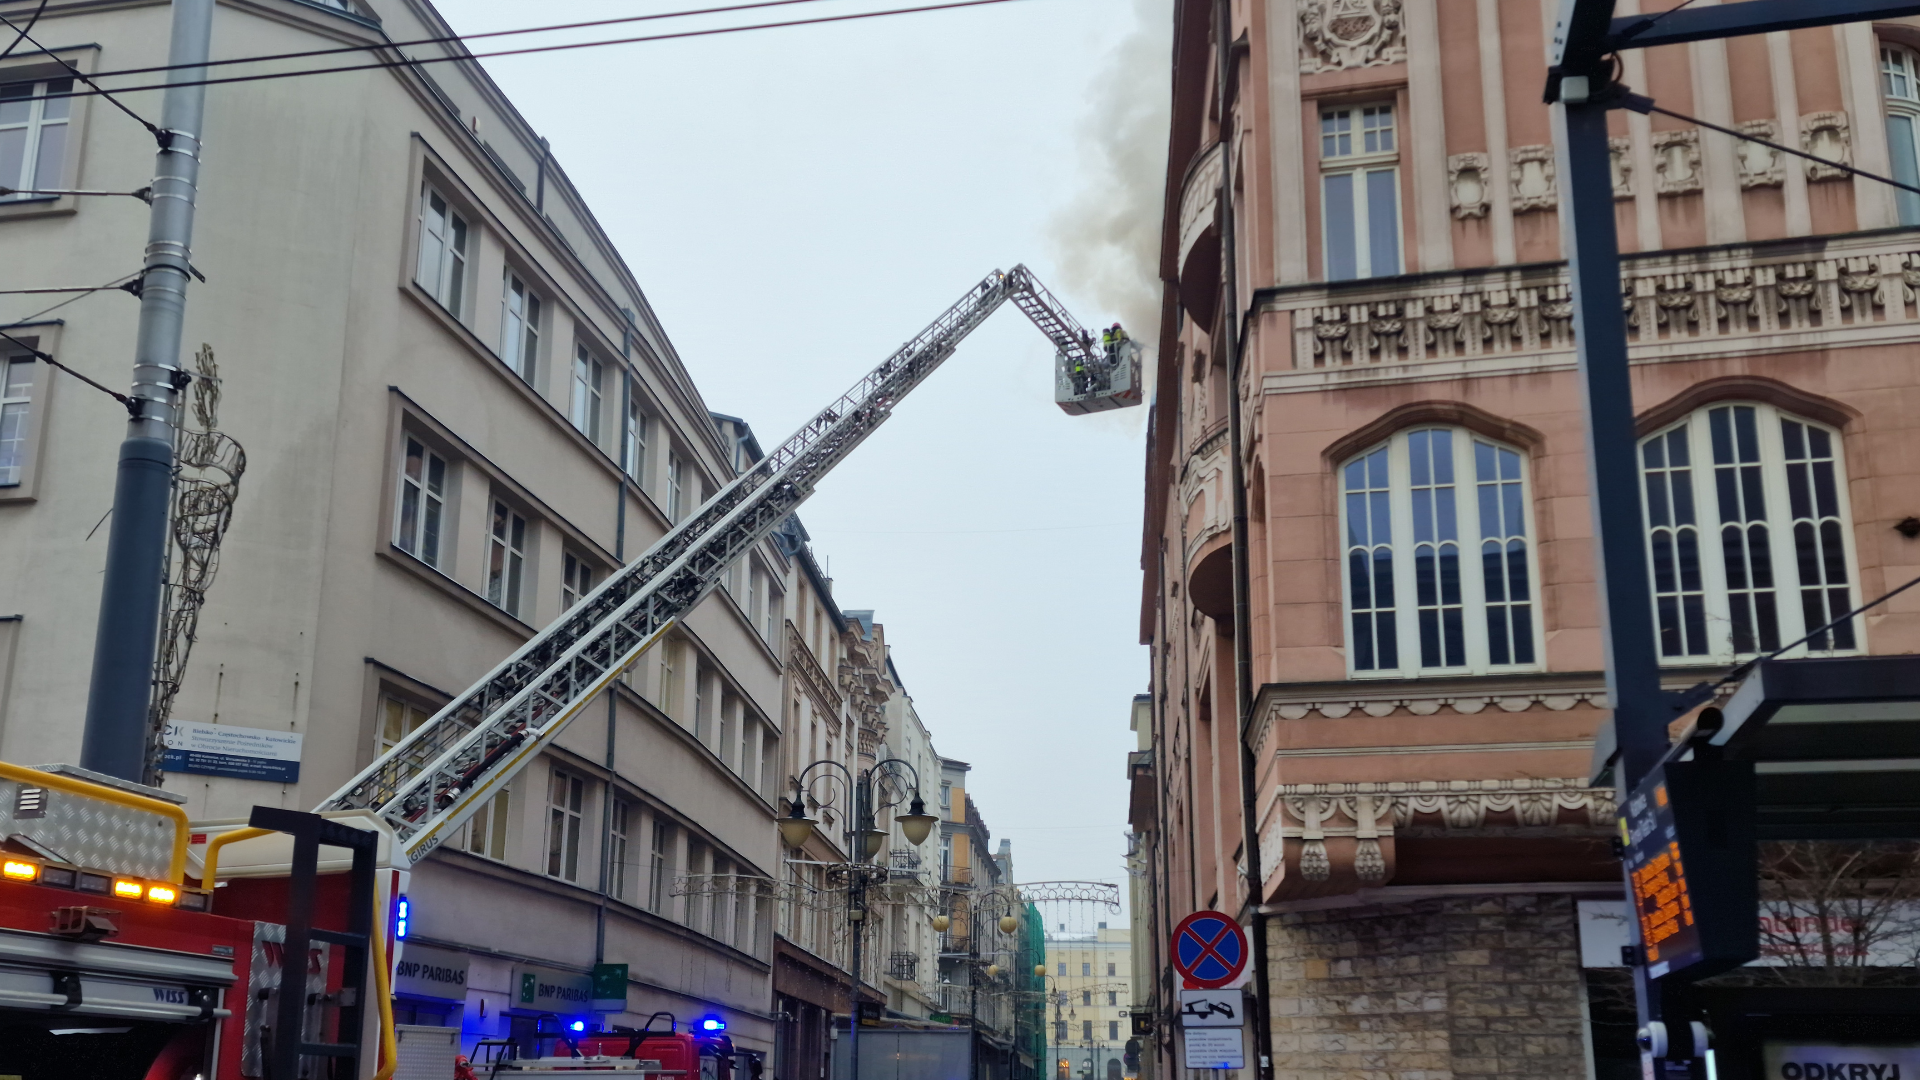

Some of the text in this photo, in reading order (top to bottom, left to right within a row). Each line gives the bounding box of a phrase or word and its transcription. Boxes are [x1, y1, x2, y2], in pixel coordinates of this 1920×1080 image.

[265, 736, 297, 745] Katowickie
[397, 961, 465, 985] BNP PARIBAS
[153, 988, 185, 1004] WISS
[538, 983, 588, 1003] BNP PARIBAS
[1781, 1062, 1900, 1080] ODKRYJ
